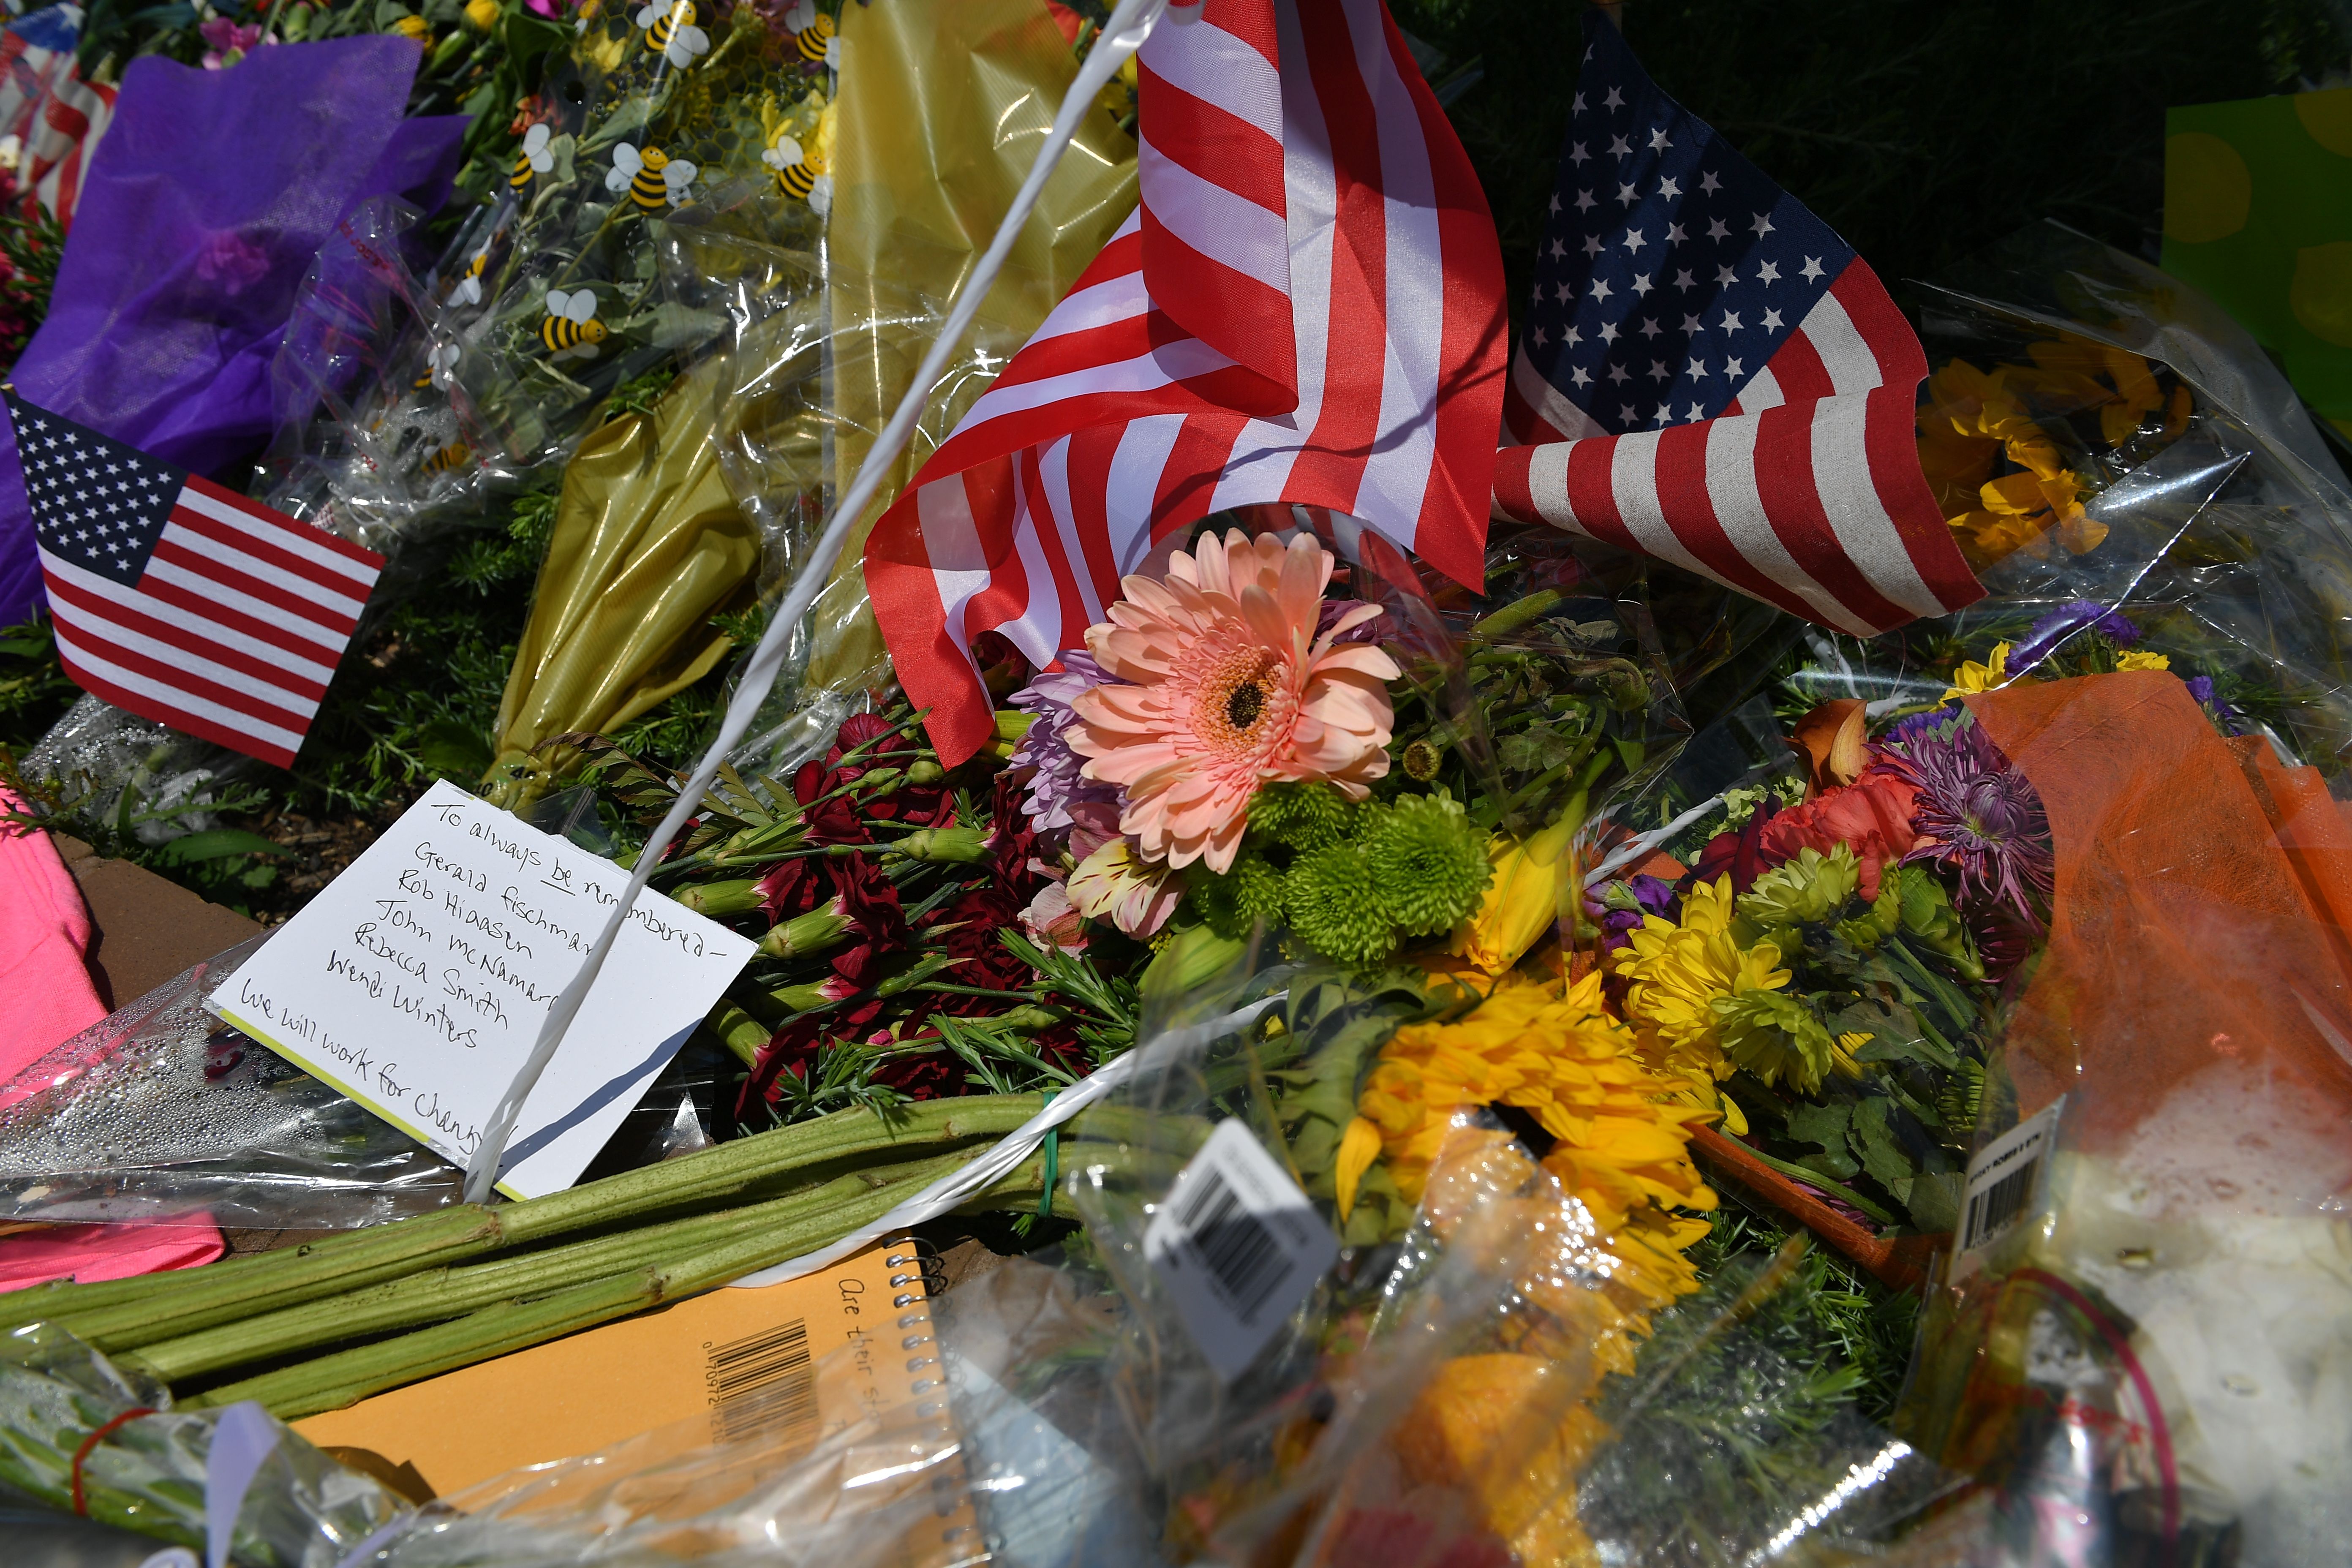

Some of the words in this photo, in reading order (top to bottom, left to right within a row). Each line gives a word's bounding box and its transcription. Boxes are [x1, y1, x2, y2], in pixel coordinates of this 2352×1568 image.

[398, 869, 434, 899] Rob
[414, 842, 487, 892] Gerald
[430, 804, 466, 826] To
[469, 823, 542, 872] always
[539, 857, 576, 896] be
[583, 882, 704, 957] remmbered
[376, 900, 431, 943] John
[327, 950, 387, 998] Wendi
[393, 985, 477, 1048] Winters
[355, 922, 428, 983] Rebecca
[443, 969, 508, 1030] Smith
[281, 1008, 316, 1042] will
[322, 1032, 373, 1081] work
[378, 1062, 411, 1097] for
[702, 1341, 712, 1349] 0
[847, 1326, 874, 1376] their
[705, 1363, 720, 1405] 70972
